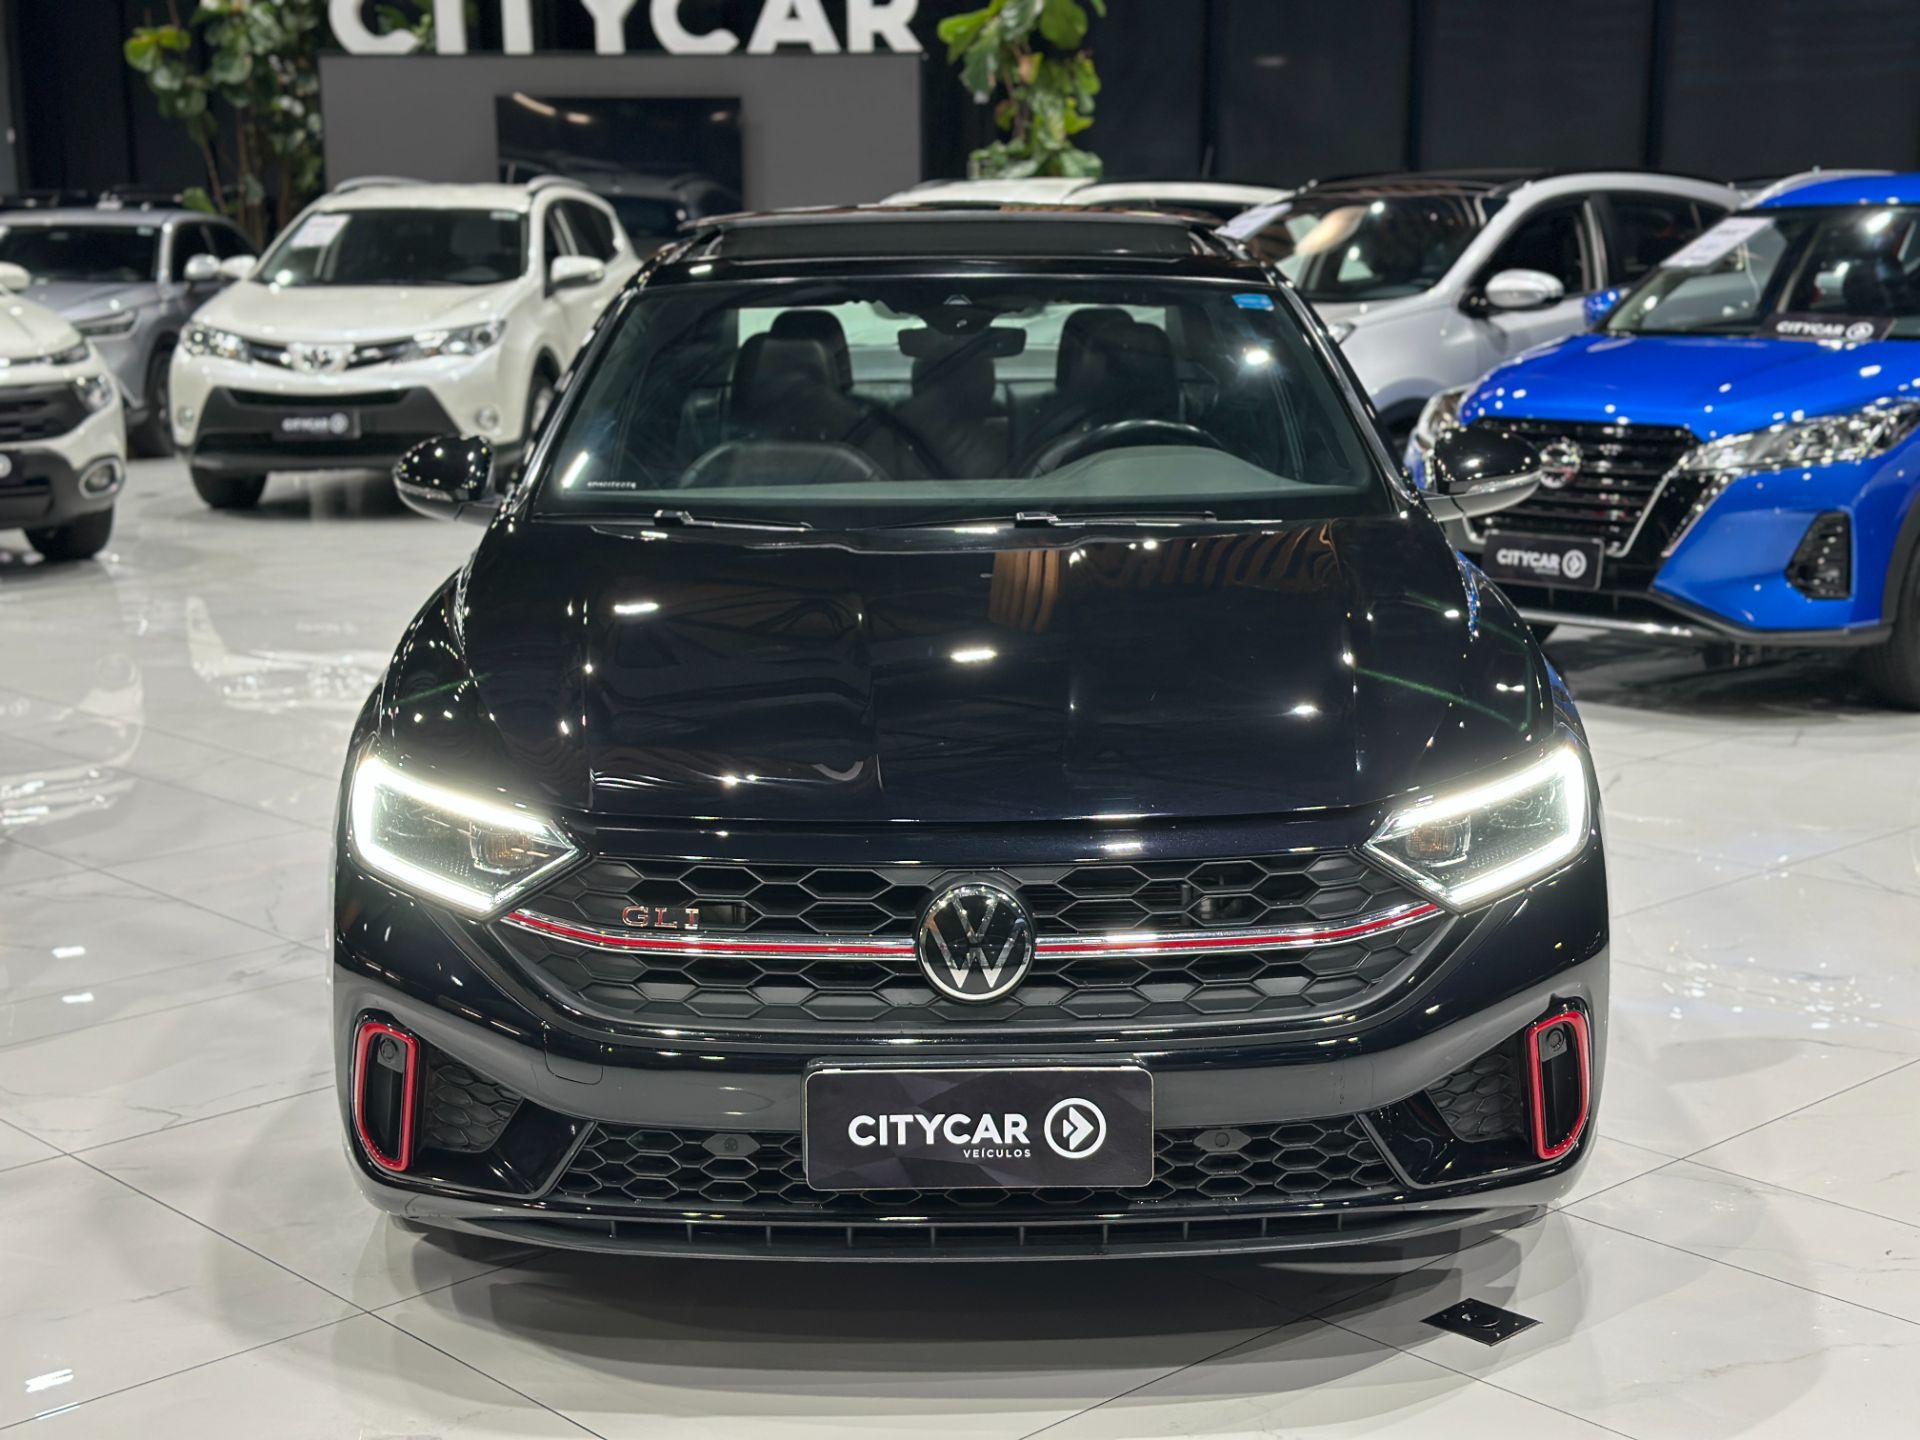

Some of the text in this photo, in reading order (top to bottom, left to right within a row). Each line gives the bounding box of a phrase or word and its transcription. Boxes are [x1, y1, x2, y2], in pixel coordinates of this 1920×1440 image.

[1496, 548, 1560, 569] CITYCAR
[622, 905, 700, 930] GLI
[848, 1112, 1031, 1147] CITYCAR
[963, 1147, 1032, 1158] VEÍCULOS
